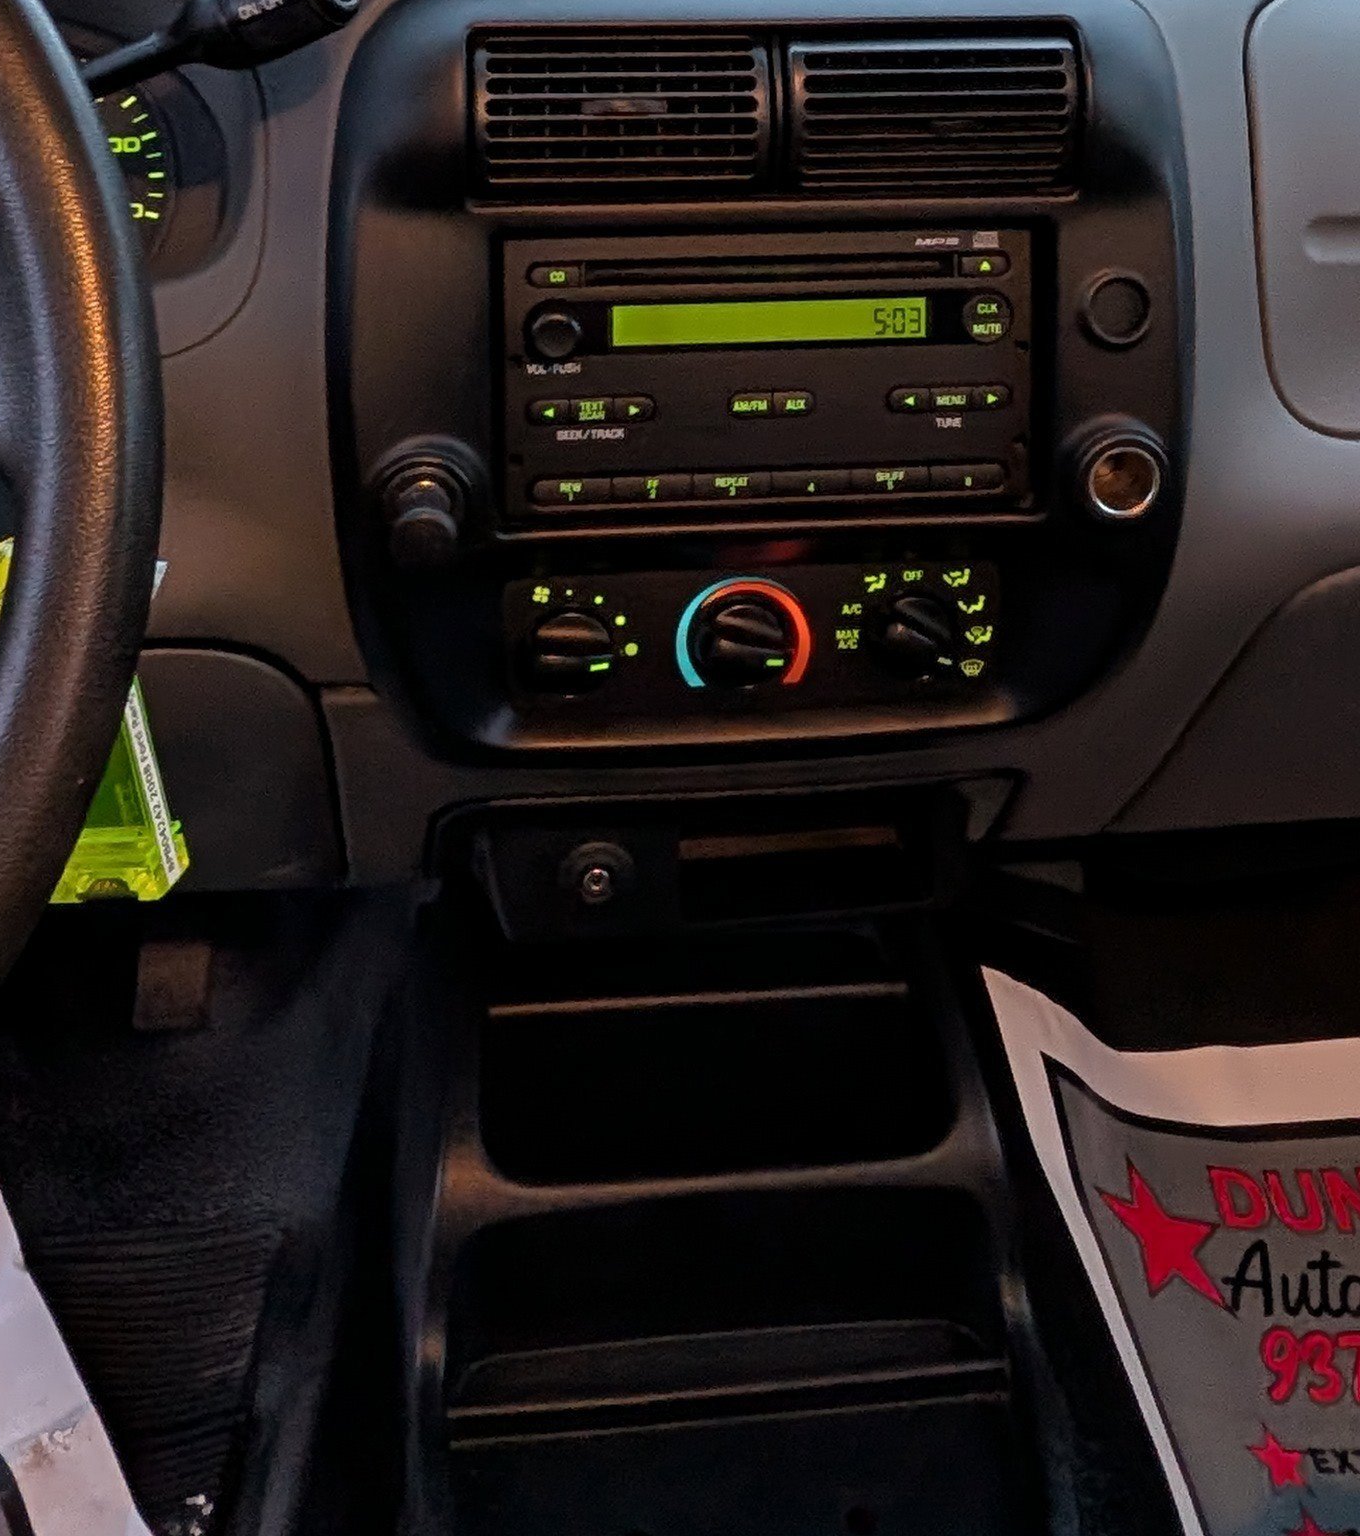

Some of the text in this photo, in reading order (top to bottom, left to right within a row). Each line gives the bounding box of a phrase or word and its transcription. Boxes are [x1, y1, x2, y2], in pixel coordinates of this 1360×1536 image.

[549, 271, 566, 283] CD
[977, 303, 998, 315] CLK
[873, 307, 922, 336] 5:03
[972, 323, 1002, 335] MUTE
[903, 570, 924, 582] OFF
[841, 603, 863, 616] A/C
